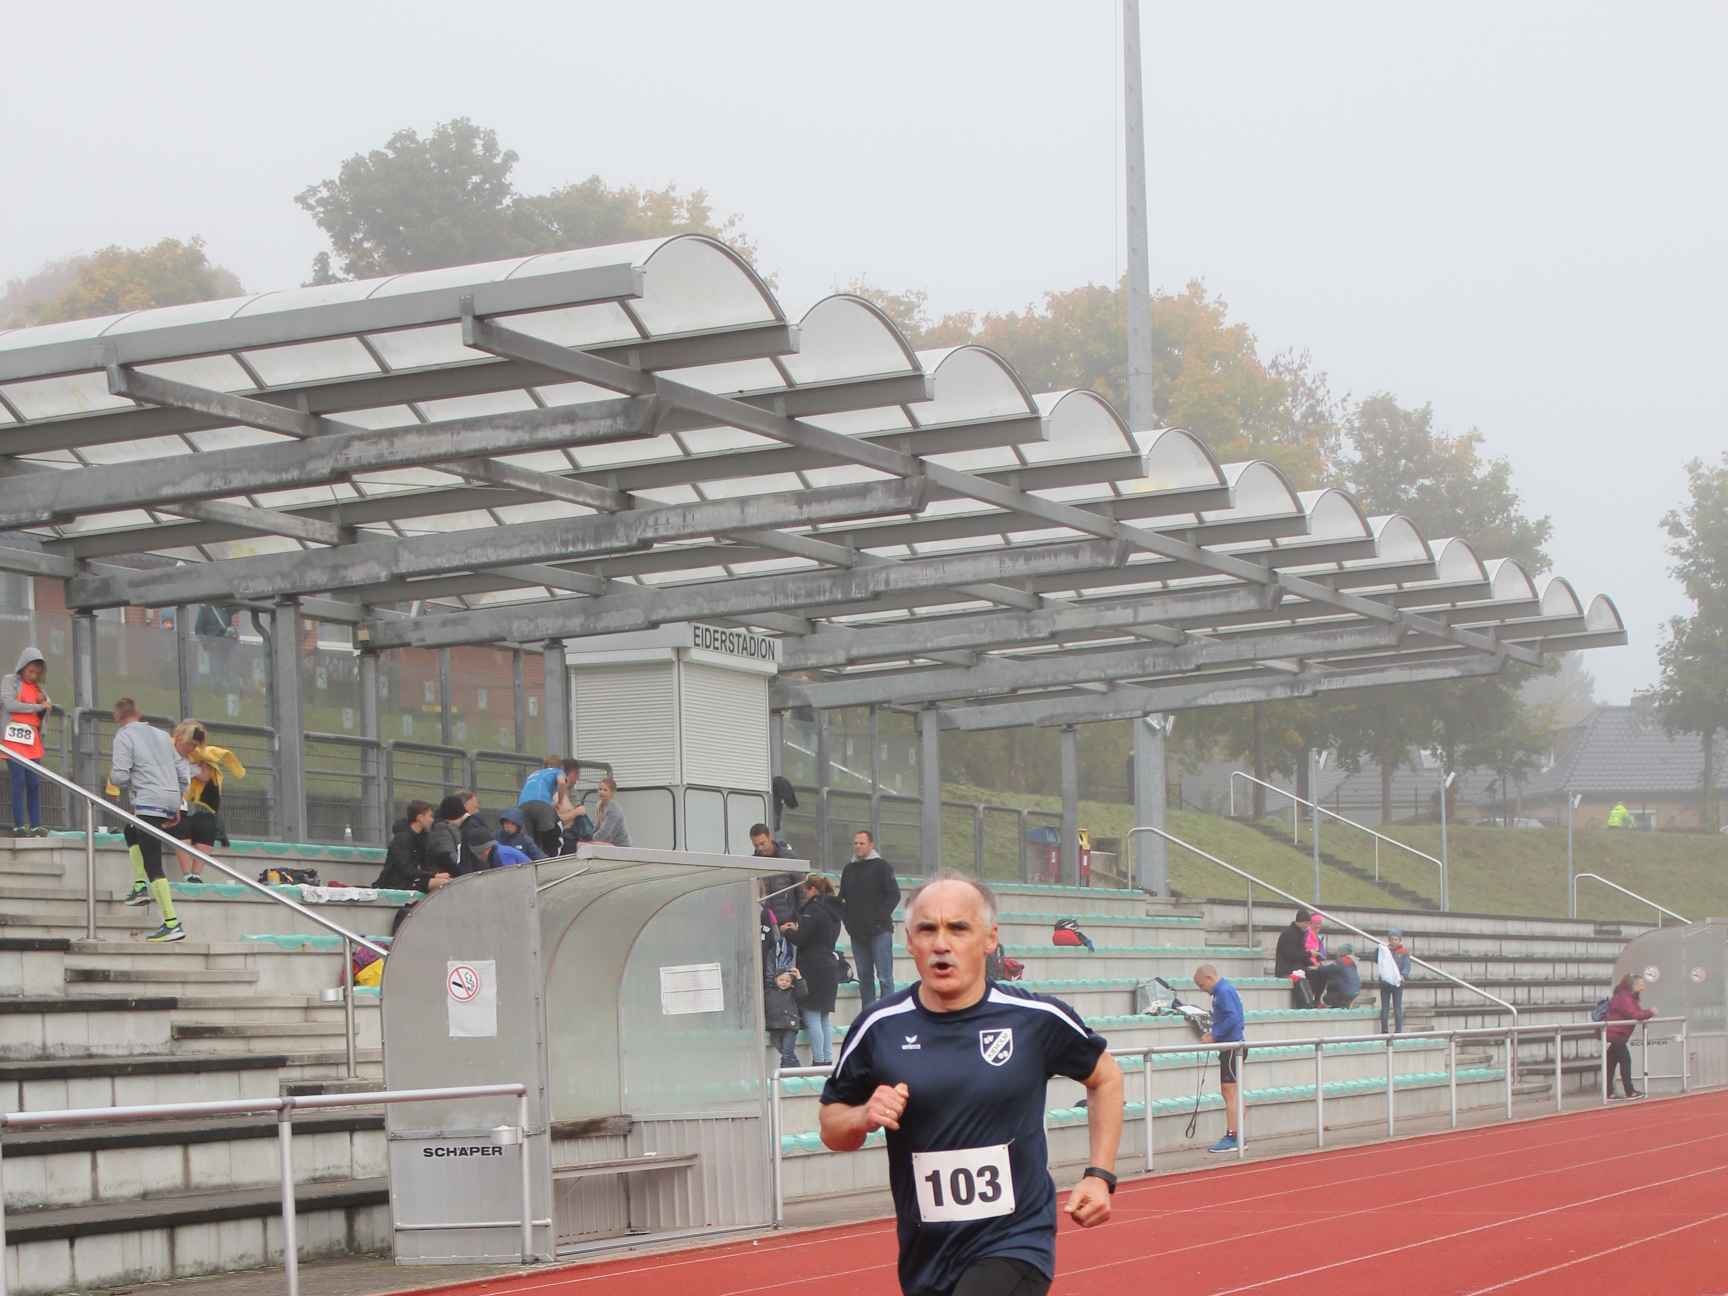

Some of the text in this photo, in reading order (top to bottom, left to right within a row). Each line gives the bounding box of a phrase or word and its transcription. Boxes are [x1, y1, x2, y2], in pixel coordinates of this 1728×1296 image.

[694, 625, 775, 660] EIDERSTADION
[8, 727, 32, 740] 388
[925, 1165, 1002, 1207] 103
